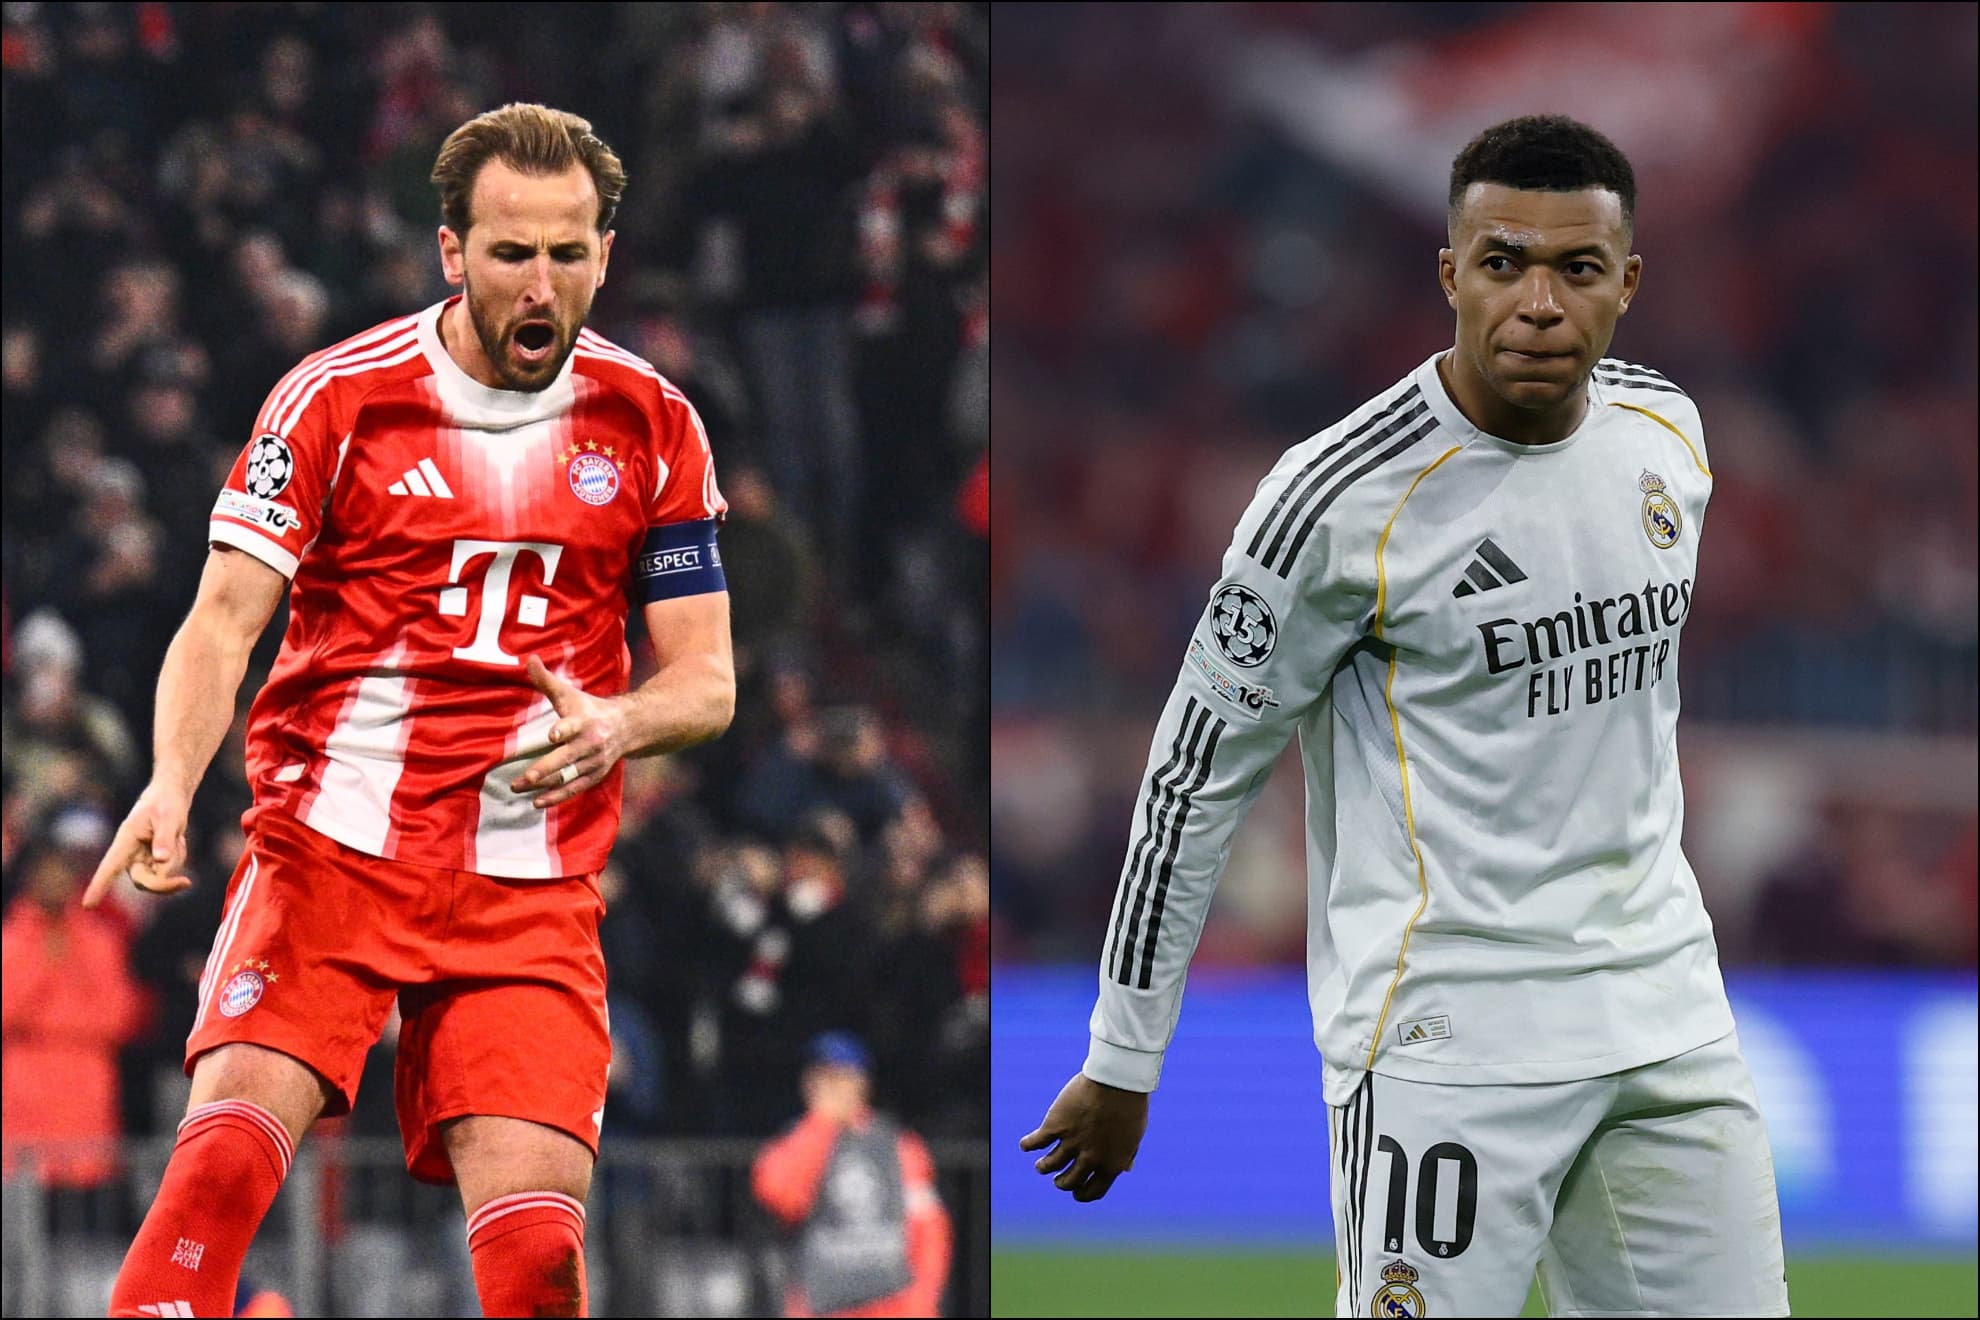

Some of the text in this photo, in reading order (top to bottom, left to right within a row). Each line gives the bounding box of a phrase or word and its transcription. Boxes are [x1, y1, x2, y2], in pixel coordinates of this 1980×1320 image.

[581, 457, 615, 478] BAYERN
[640, 551, 700, 573] RESPECT
[439, 539, 564, 666] T
[1224, 605, 1258, 644] 15
[1477, 578, 1691, 674] Emirates
[1528, 638, 1669, 717] FLY BETTER
[1378, 1134, 1478, 1259] 10
